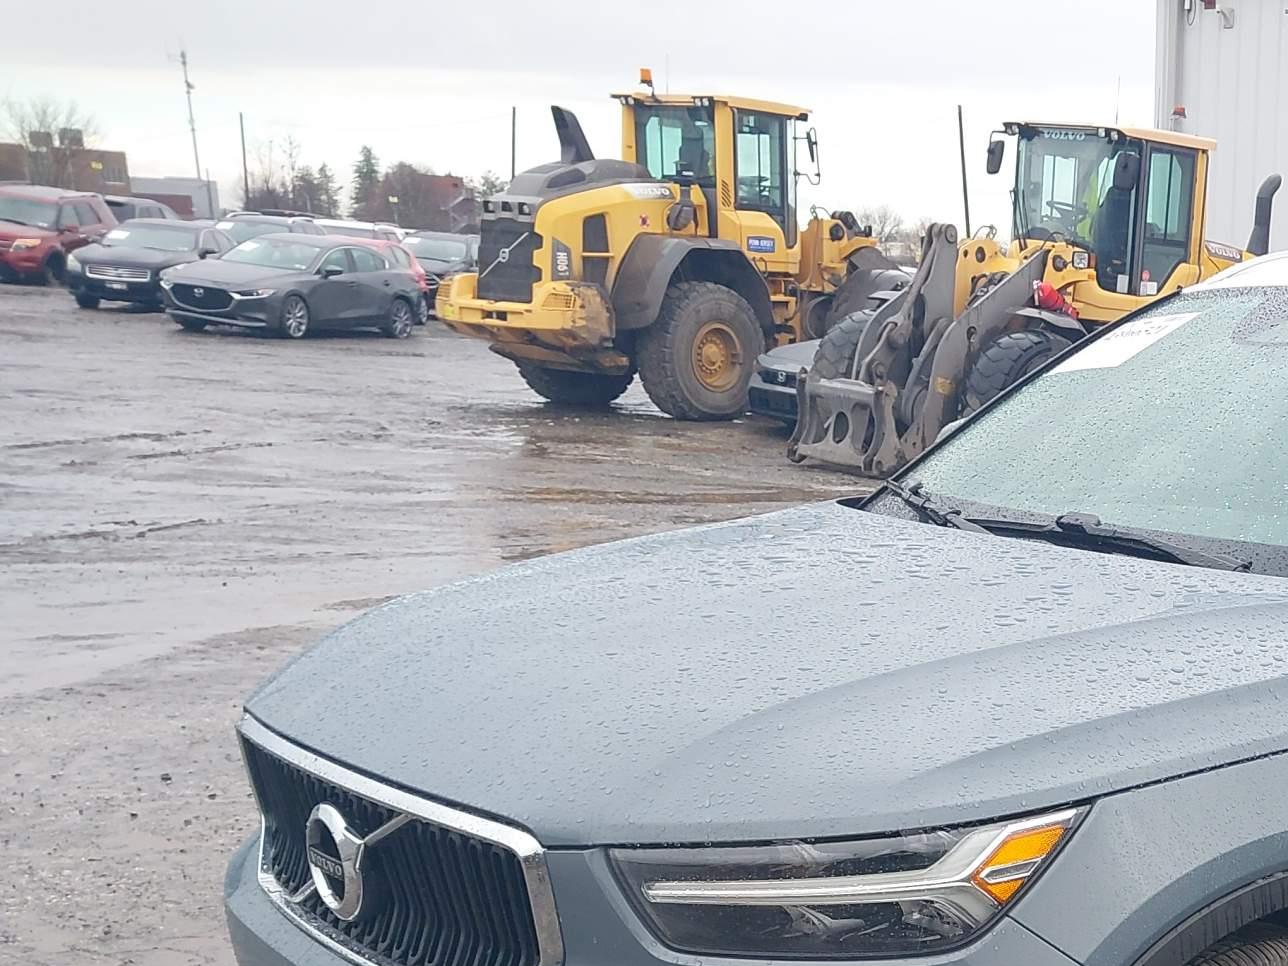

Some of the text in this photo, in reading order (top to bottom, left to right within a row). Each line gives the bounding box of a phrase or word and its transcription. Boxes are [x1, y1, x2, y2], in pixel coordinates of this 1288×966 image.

[1043, 130, 1086, 141] VOLVO
[1208, 243, 1241, 259] VOLVO
[310, 849, 343, 876] VOLVO
